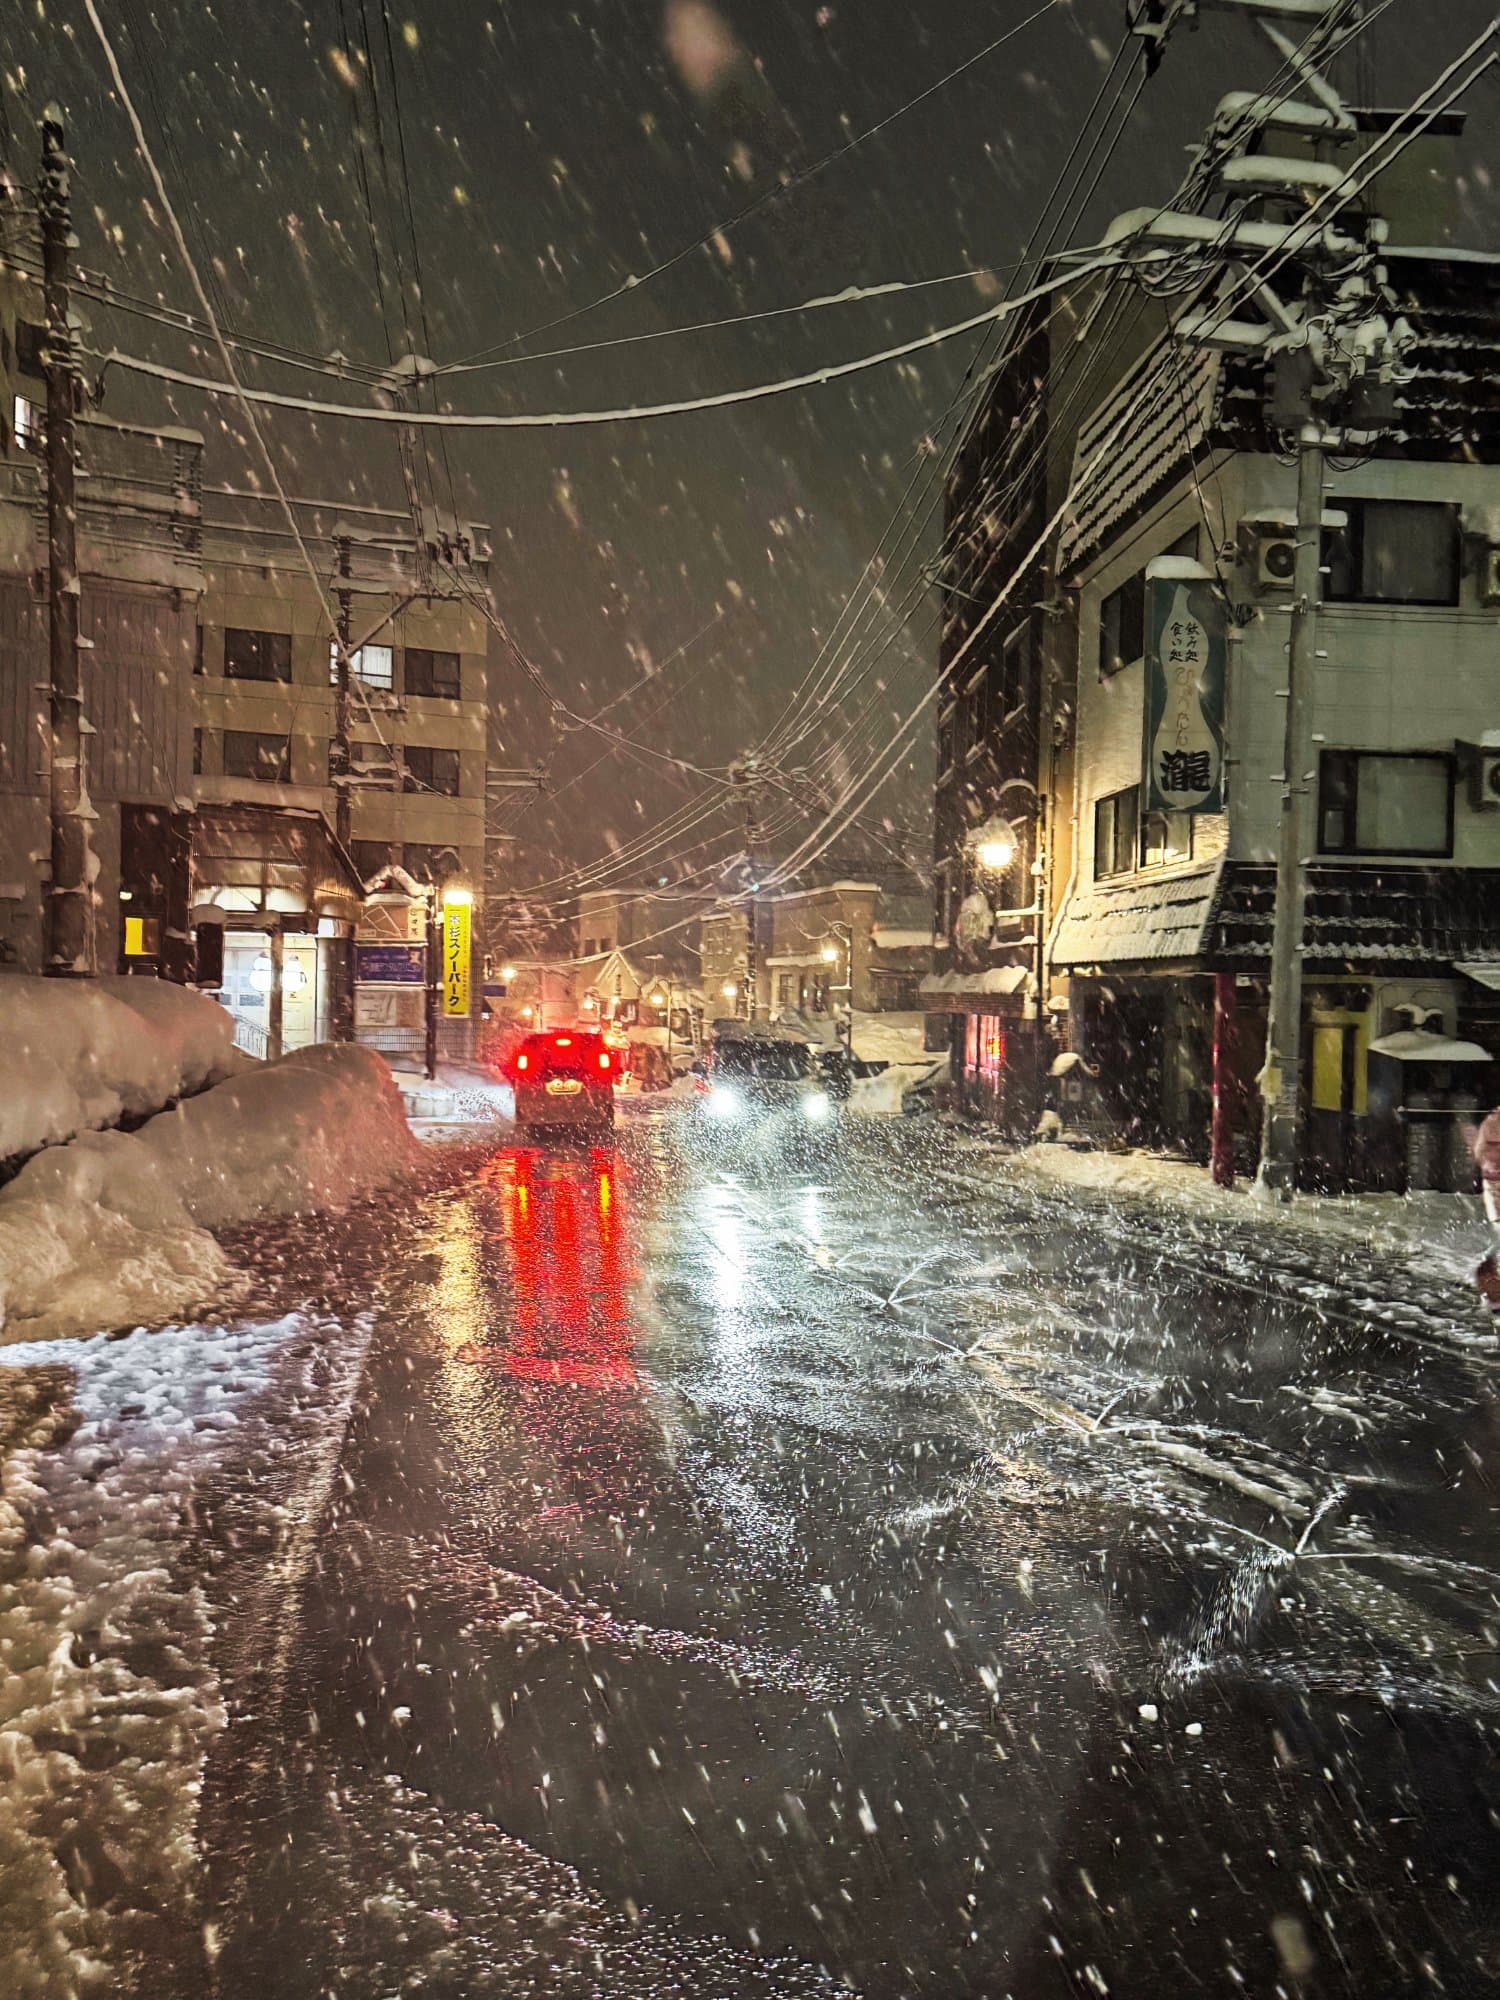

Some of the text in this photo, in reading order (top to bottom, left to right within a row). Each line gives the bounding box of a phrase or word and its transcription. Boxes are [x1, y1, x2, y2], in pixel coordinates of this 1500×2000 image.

[1169, 622, 1184, 662] 食い処
[1185, 622, 1199, 662] 飲み処
[448, 908, 461, 1007] 一本杉スノーパーク
